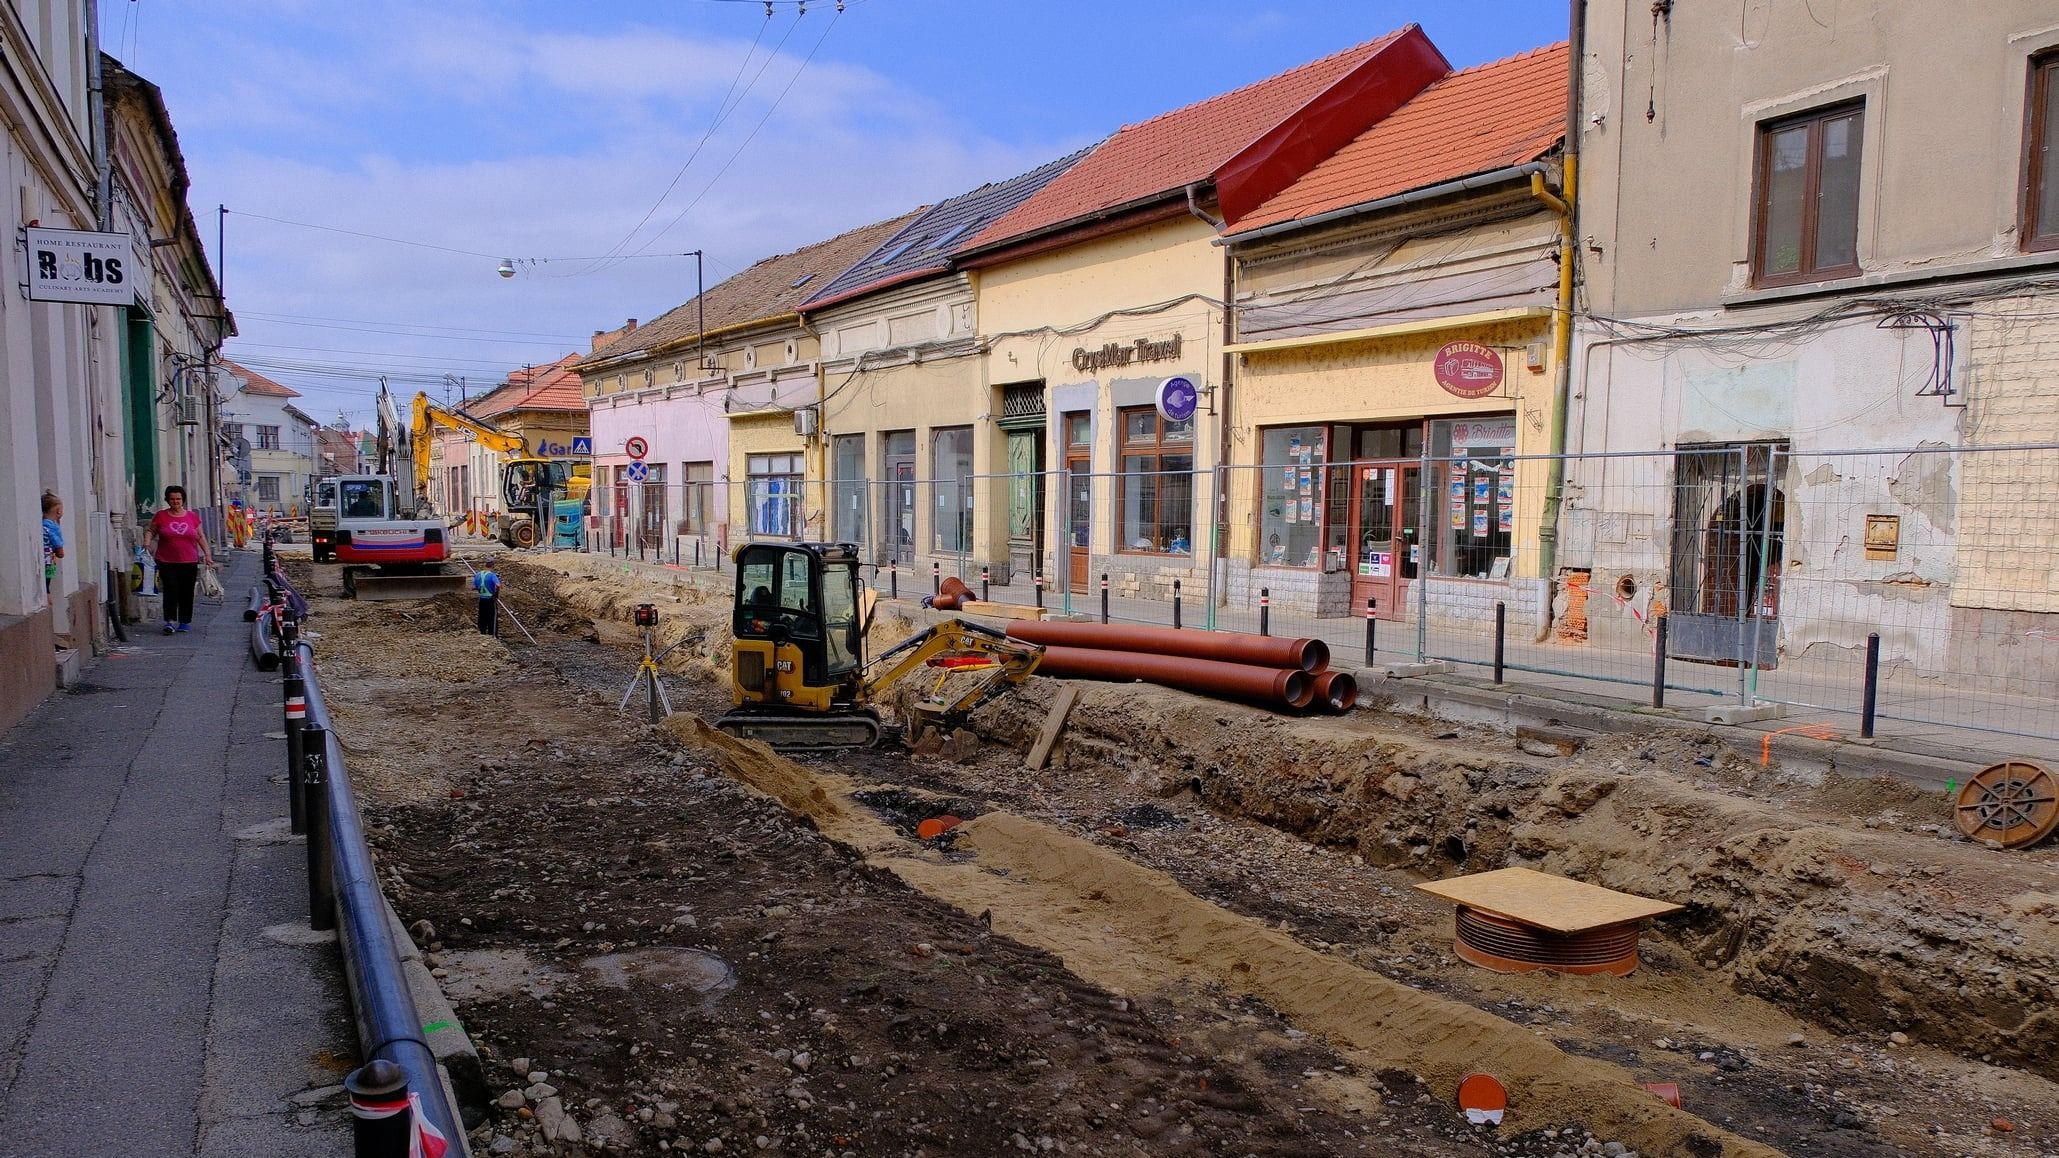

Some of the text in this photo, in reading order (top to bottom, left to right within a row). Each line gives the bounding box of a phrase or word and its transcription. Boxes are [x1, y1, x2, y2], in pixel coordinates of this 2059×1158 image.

[37, 239, 122, 250] HOME RESTAURANT
[1445, 343, 1493, 360] BRIGITTE
[1472, 423, 1516, 445] Brigitte
[960, 636, 974, 646] CAT
[777, 660, 792, 672] CAT
